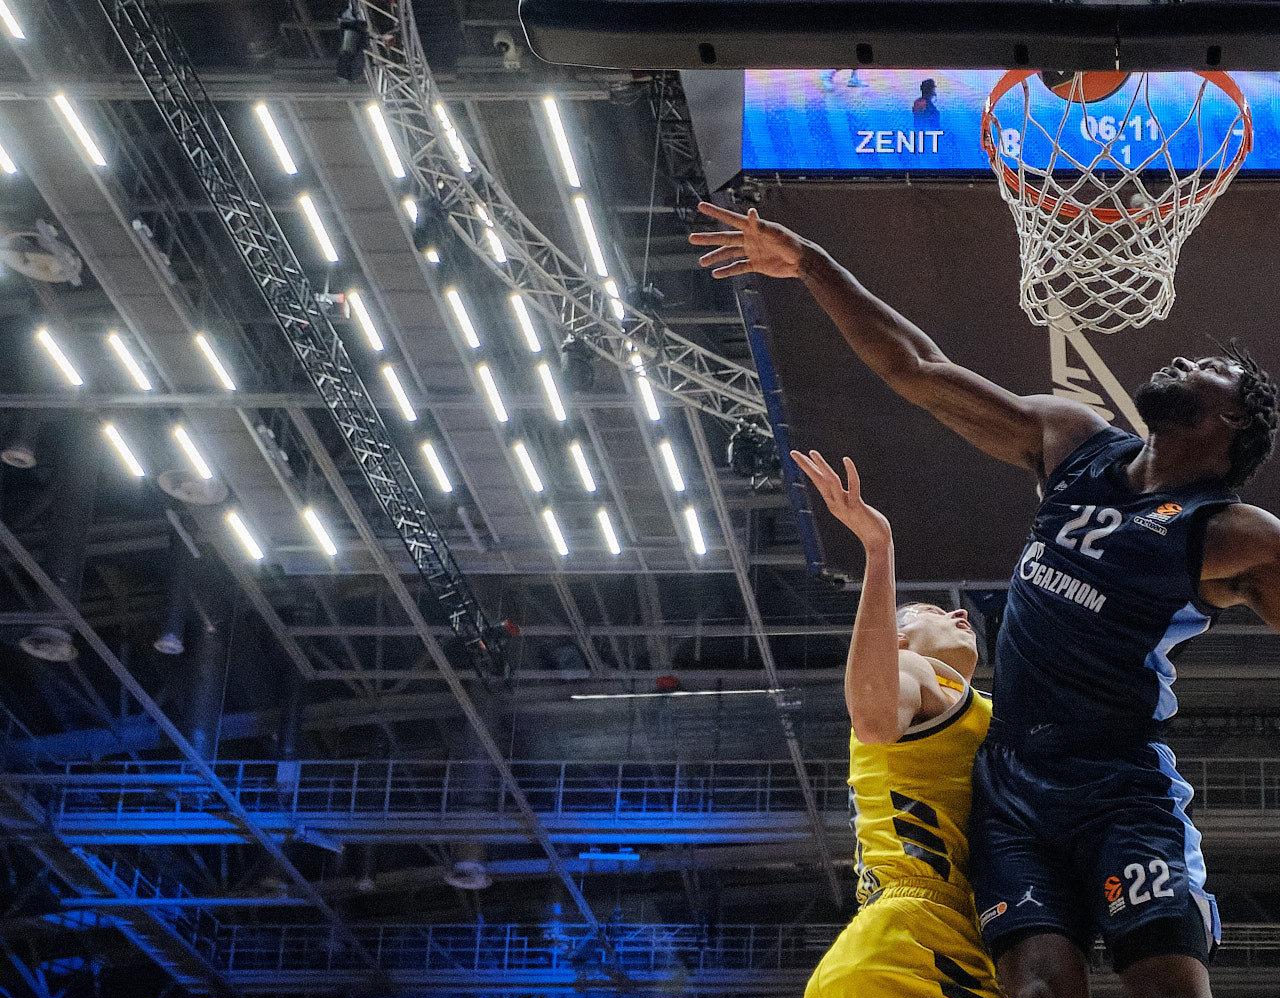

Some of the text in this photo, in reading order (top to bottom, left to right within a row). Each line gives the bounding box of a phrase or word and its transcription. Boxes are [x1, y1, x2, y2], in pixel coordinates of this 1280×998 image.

[856, 131, 943, 153] ZENIT
[1081, 115, 1159, 142] 06:11
[1056, 504, 1122, 560] 22
[1032, 564, 1107, 613] GAZPROM
[1124, 859, 1174, 905] 22
